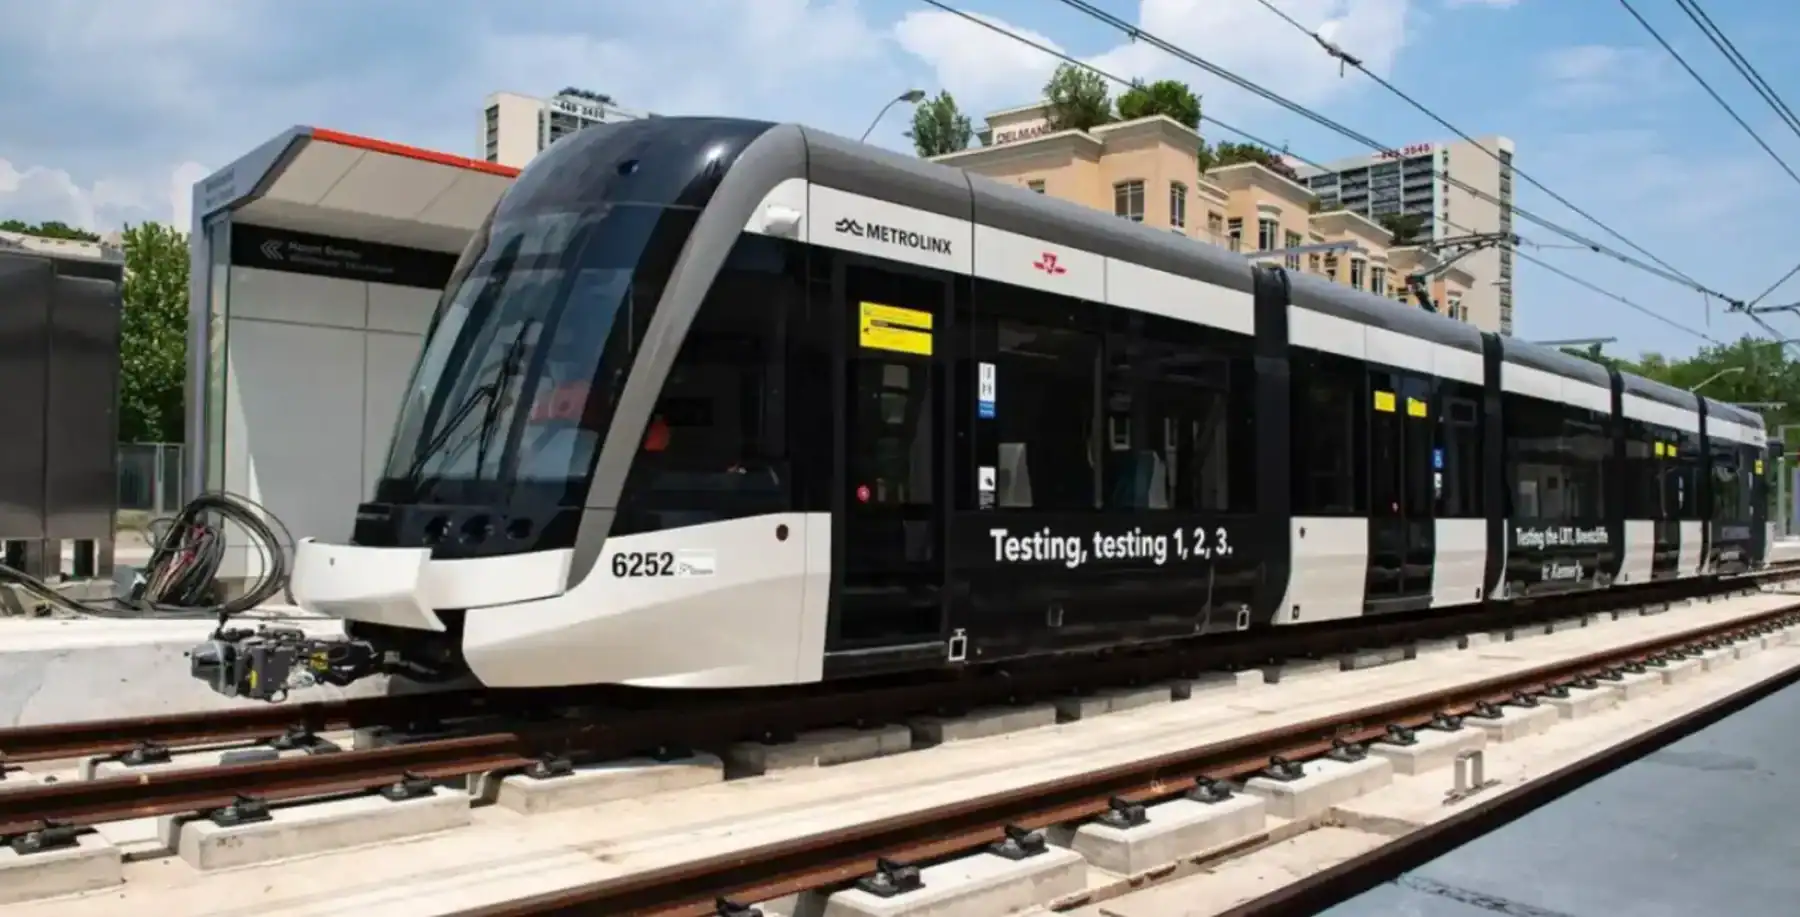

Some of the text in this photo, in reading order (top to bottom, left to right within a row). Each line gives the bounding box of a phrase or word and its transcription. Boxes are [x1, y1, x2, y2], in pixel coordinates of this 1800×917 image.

[866, 222, 952, 255] METROLINX
[990, 526, 1233, 568] Testing, testing 1, 2, 3.
[612, 552, 674, 577] 6252
